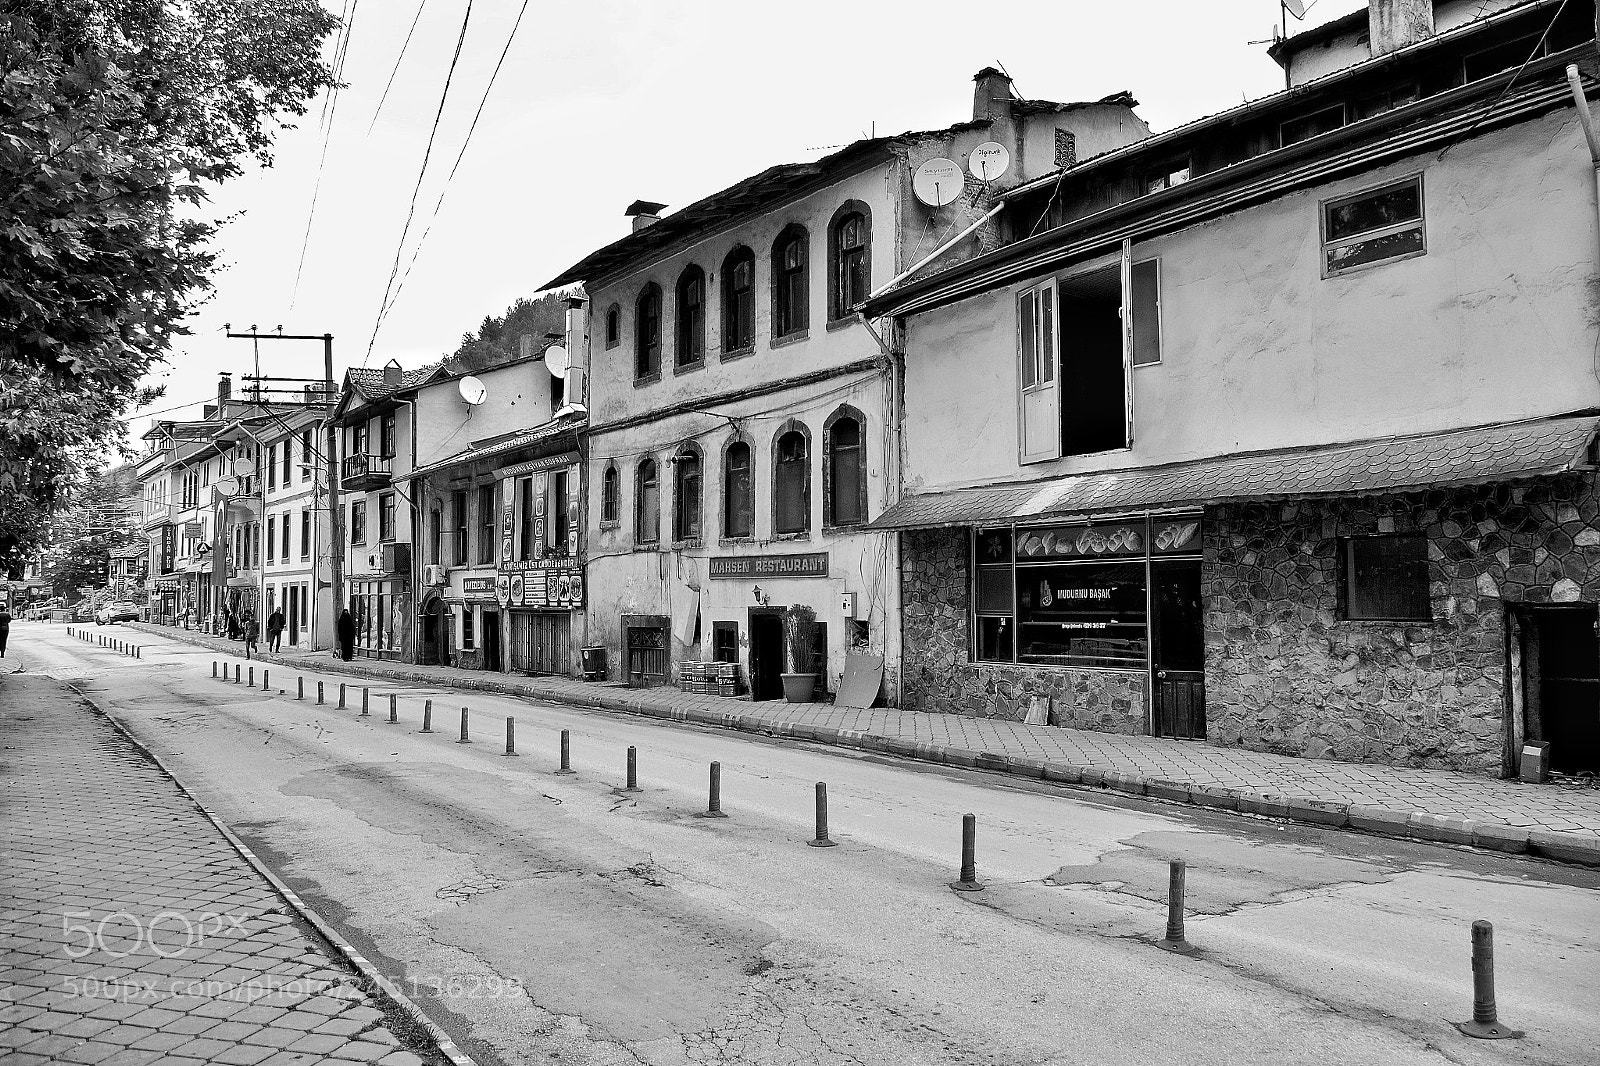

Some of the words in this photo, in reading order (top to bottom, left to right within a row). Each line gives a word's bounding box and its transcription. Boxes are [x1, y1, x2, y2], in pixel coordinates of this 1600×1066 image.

[710, 561, 750, 574] MAHSEN
[755, 558, 825, 573] RESTAURANT
[1057, 588, 1088, 599] MUDURNU
[1089, 588, 1111, 601] BAŞAK
